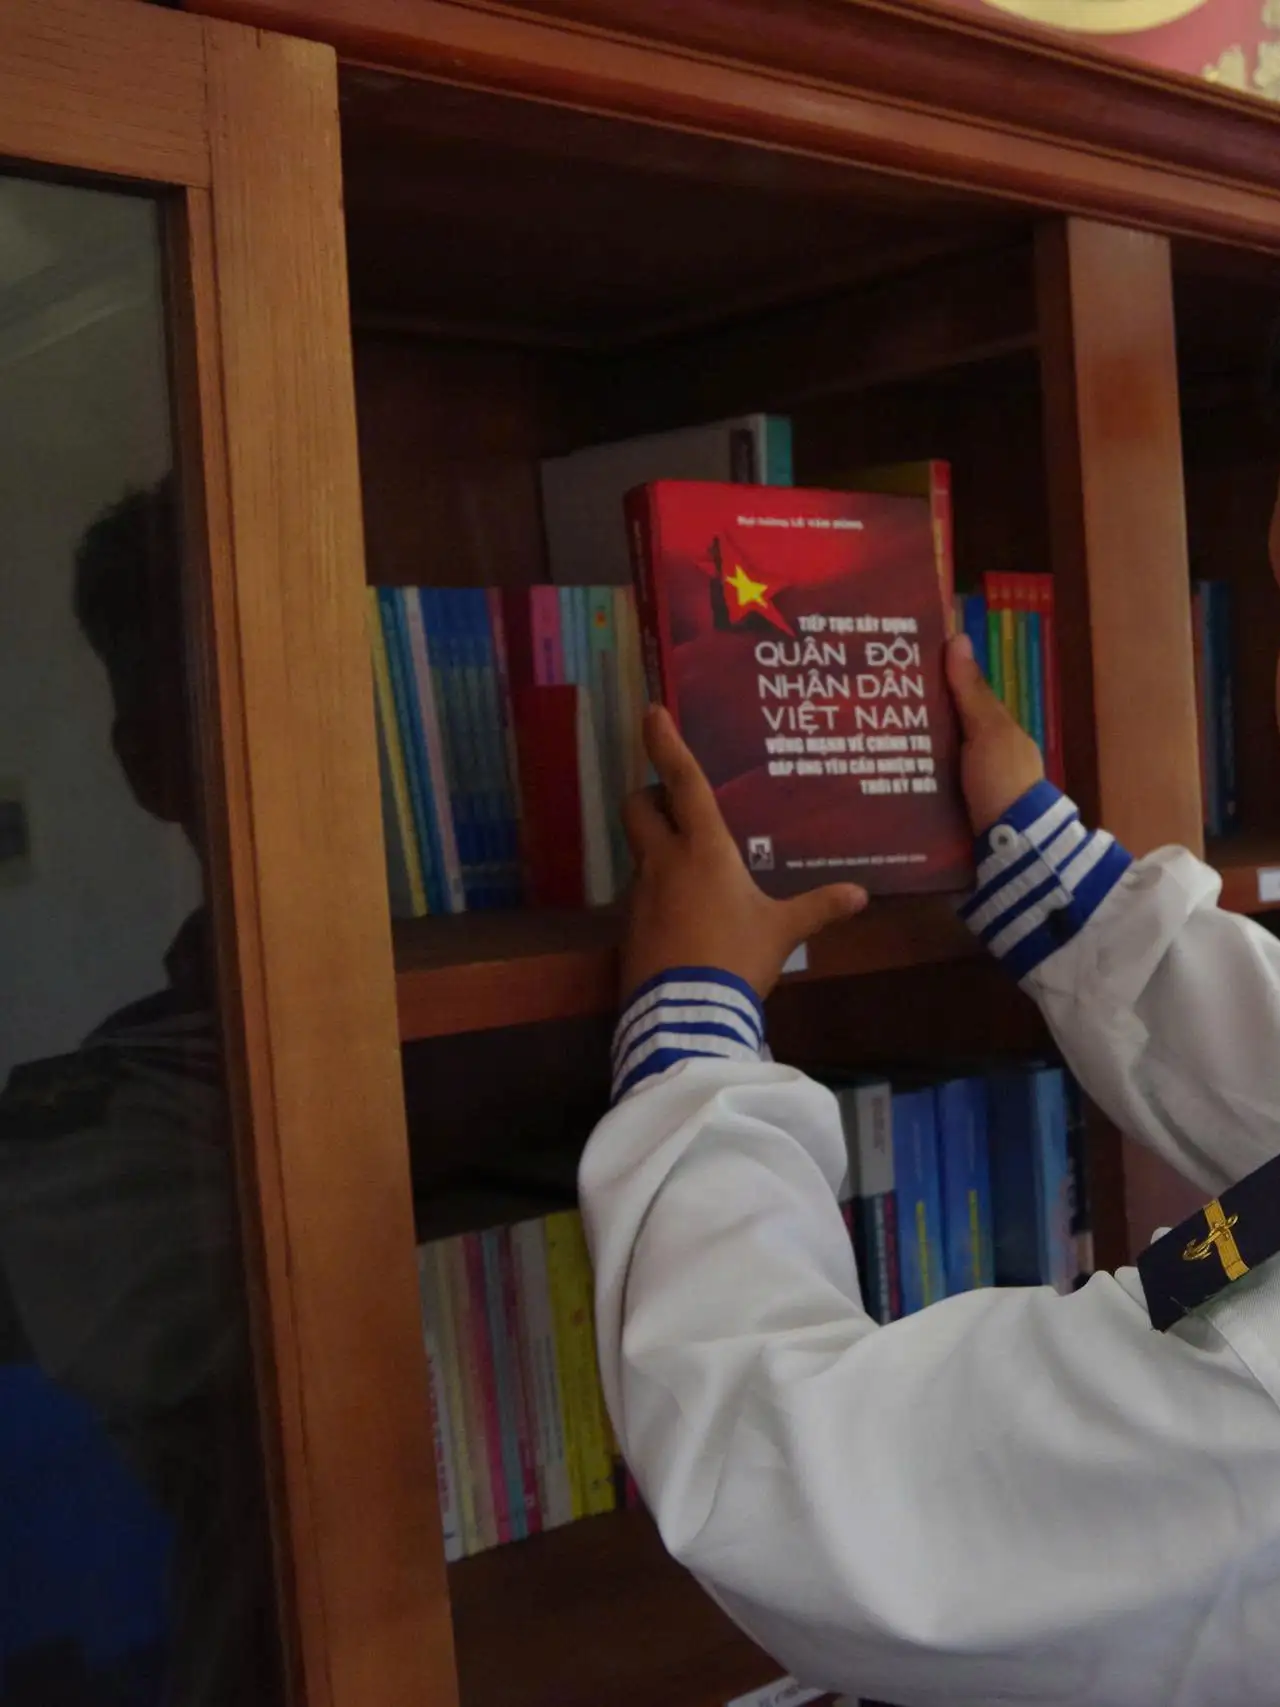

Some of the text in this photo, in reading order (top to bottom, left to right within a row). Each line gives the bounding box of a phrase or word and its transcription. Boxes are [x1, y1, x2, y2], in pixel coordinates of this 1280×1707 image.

[755, 636, 921, 670] QUÂN ĐỘI
[757, 668, 925, 699] NHÂN DÂN
[761, 700, 929, 735] VIỆT NAM
